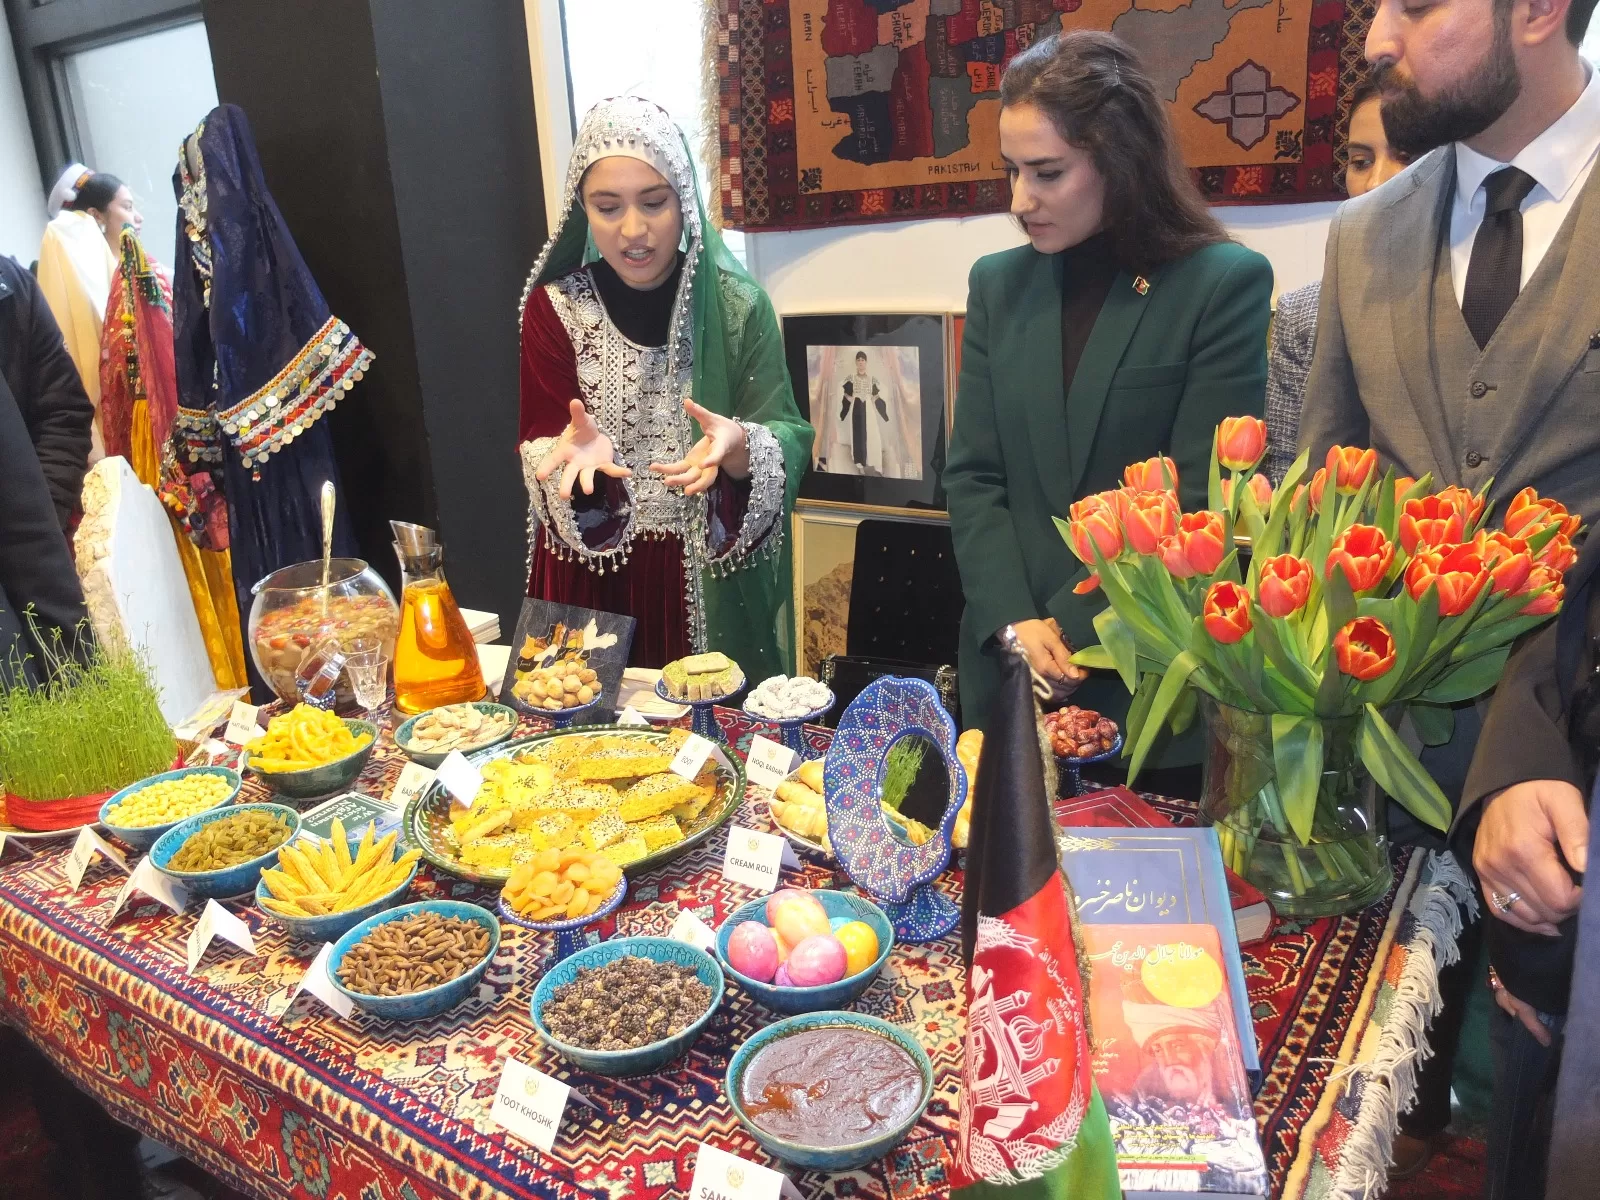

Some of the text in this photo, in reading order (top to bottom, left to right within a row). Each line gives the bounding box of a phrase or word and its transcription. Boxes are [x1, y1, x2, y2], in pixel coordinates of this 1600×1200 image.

[928, 162, 980, 175] PAKISTAN
[310, 802, 358, 827] Afghanen
[351, 809, 377, 822] Wie
[730, 857, 773, 875] CREAM ROLL
[499, 1093, 554, 1130] TOOT KHOSHK
[700, 1187, 734, 1200] SAM
